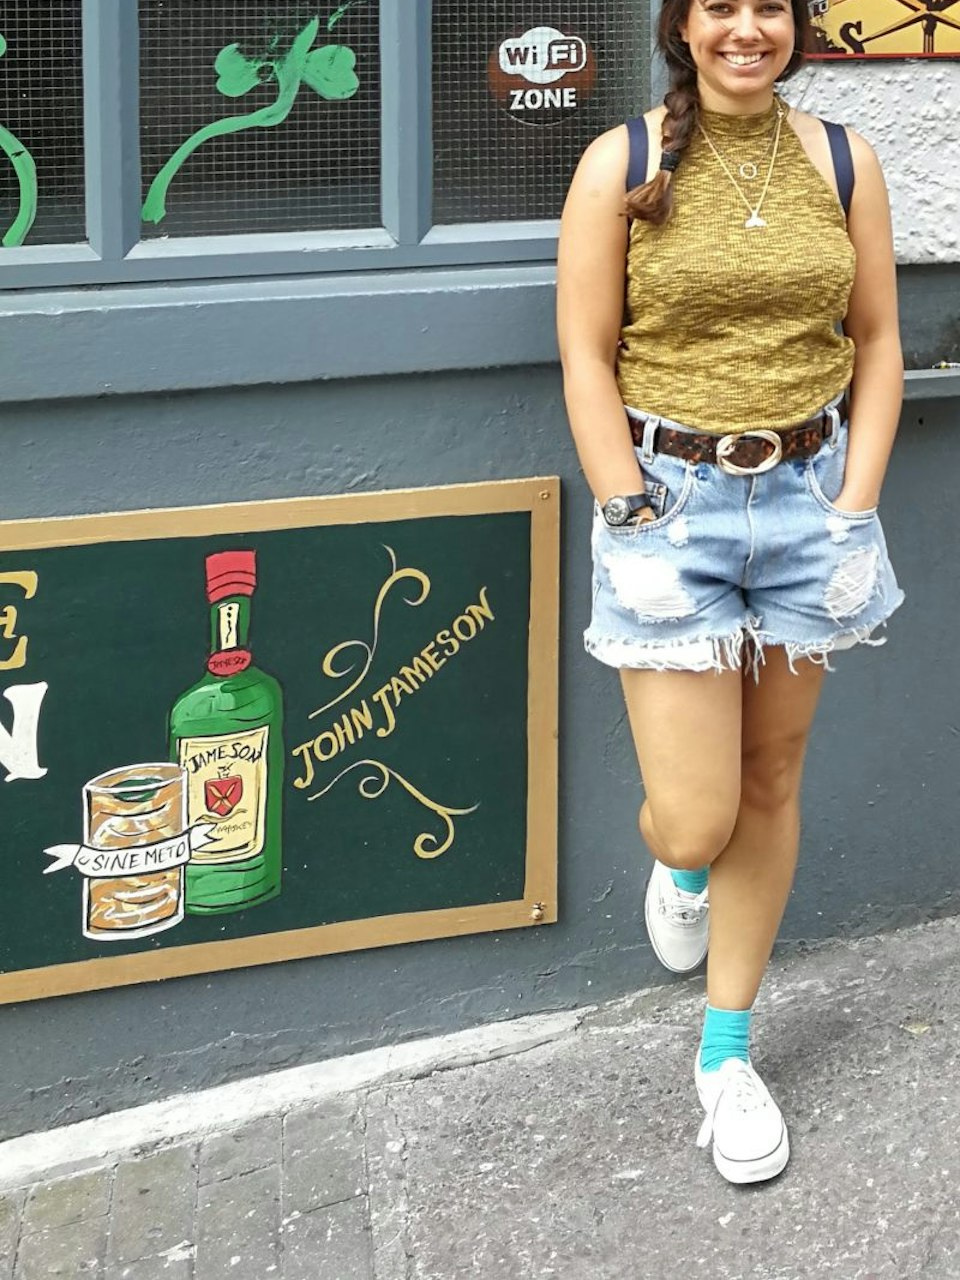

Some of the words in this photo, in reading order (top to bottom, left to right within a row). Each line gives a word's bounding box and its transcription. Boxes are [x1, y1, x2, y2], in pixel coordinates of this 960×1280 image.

[509, 87, 577, 110] ZONE
[291, 699, 374, 789] JOHN
[371, 585, 496, 738] JAMESON
[188, 742, 262, 775] JAMESON
[92, 853, 141, 872] SINE
